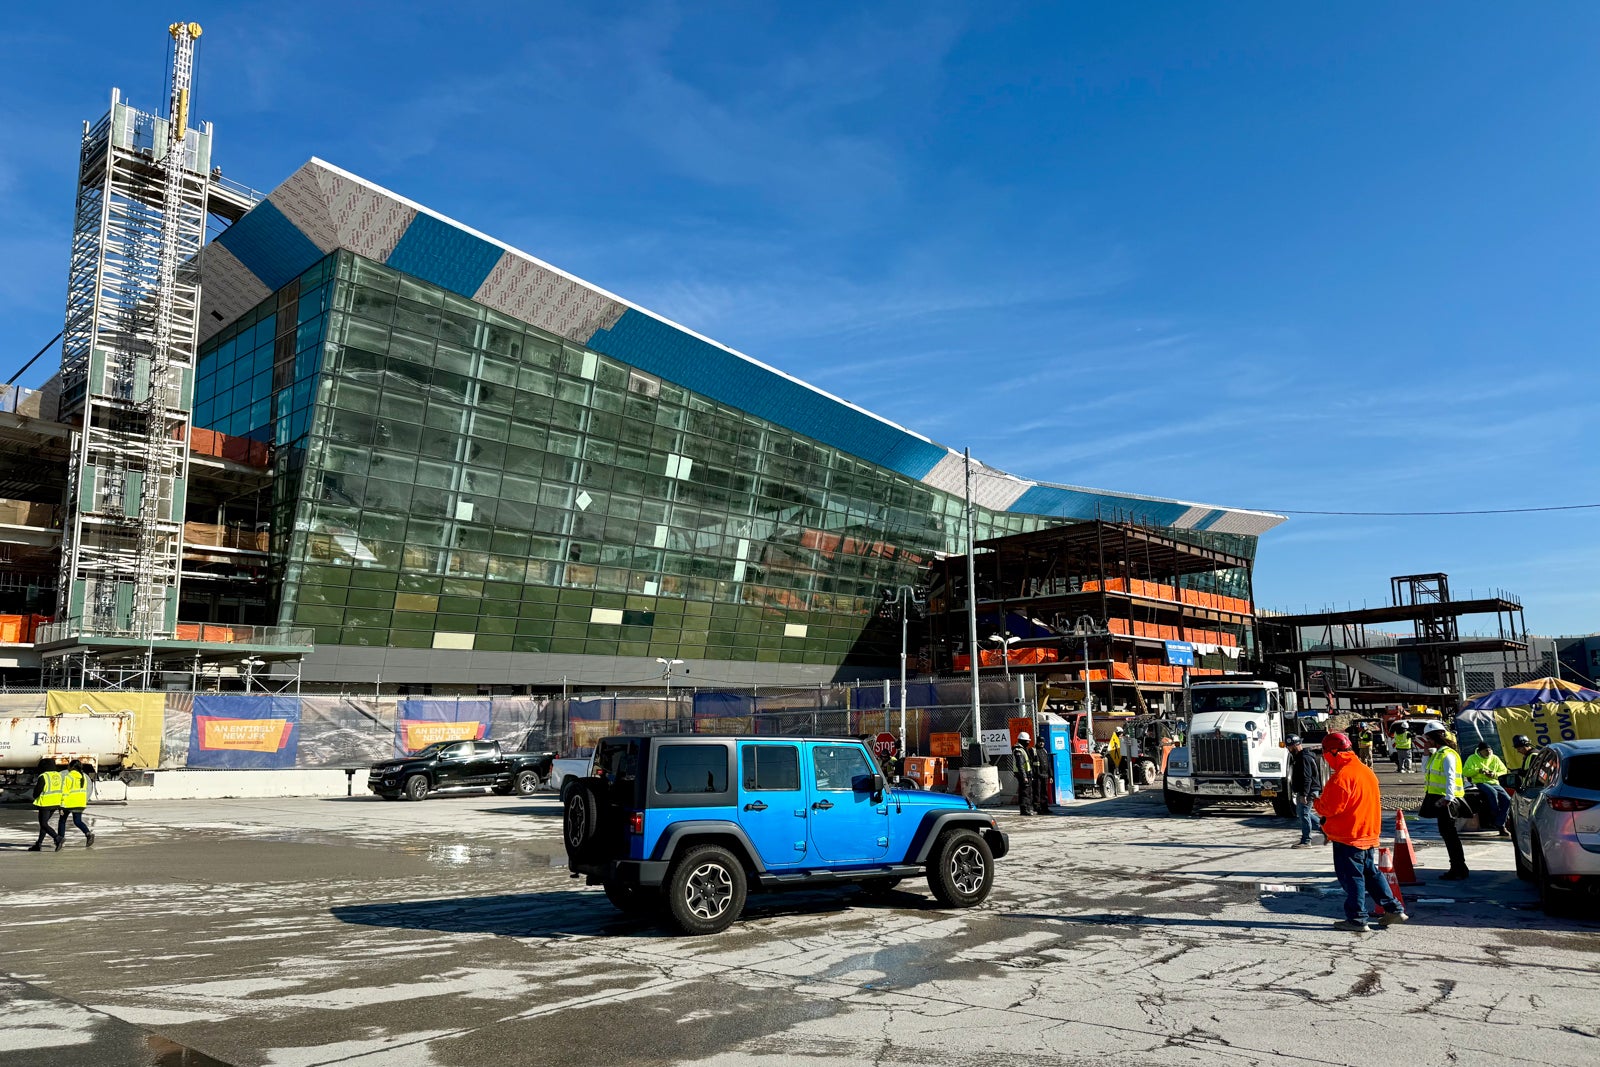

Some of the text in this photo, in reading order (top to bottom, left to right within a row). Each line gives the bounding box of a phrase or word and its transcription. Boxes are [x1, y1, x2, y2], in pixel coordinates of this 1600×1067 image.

[230, 725, 276, 733] ENTIRELY
[415, 727, 470, 735] AN ENTIRELY
[30, 732, 82, 746] FERREIRA
[223, 732, 266, 740] NEW JFK
[980, 733, 1007, 743] G-22A
[875, 741, 896, 753] STOP
